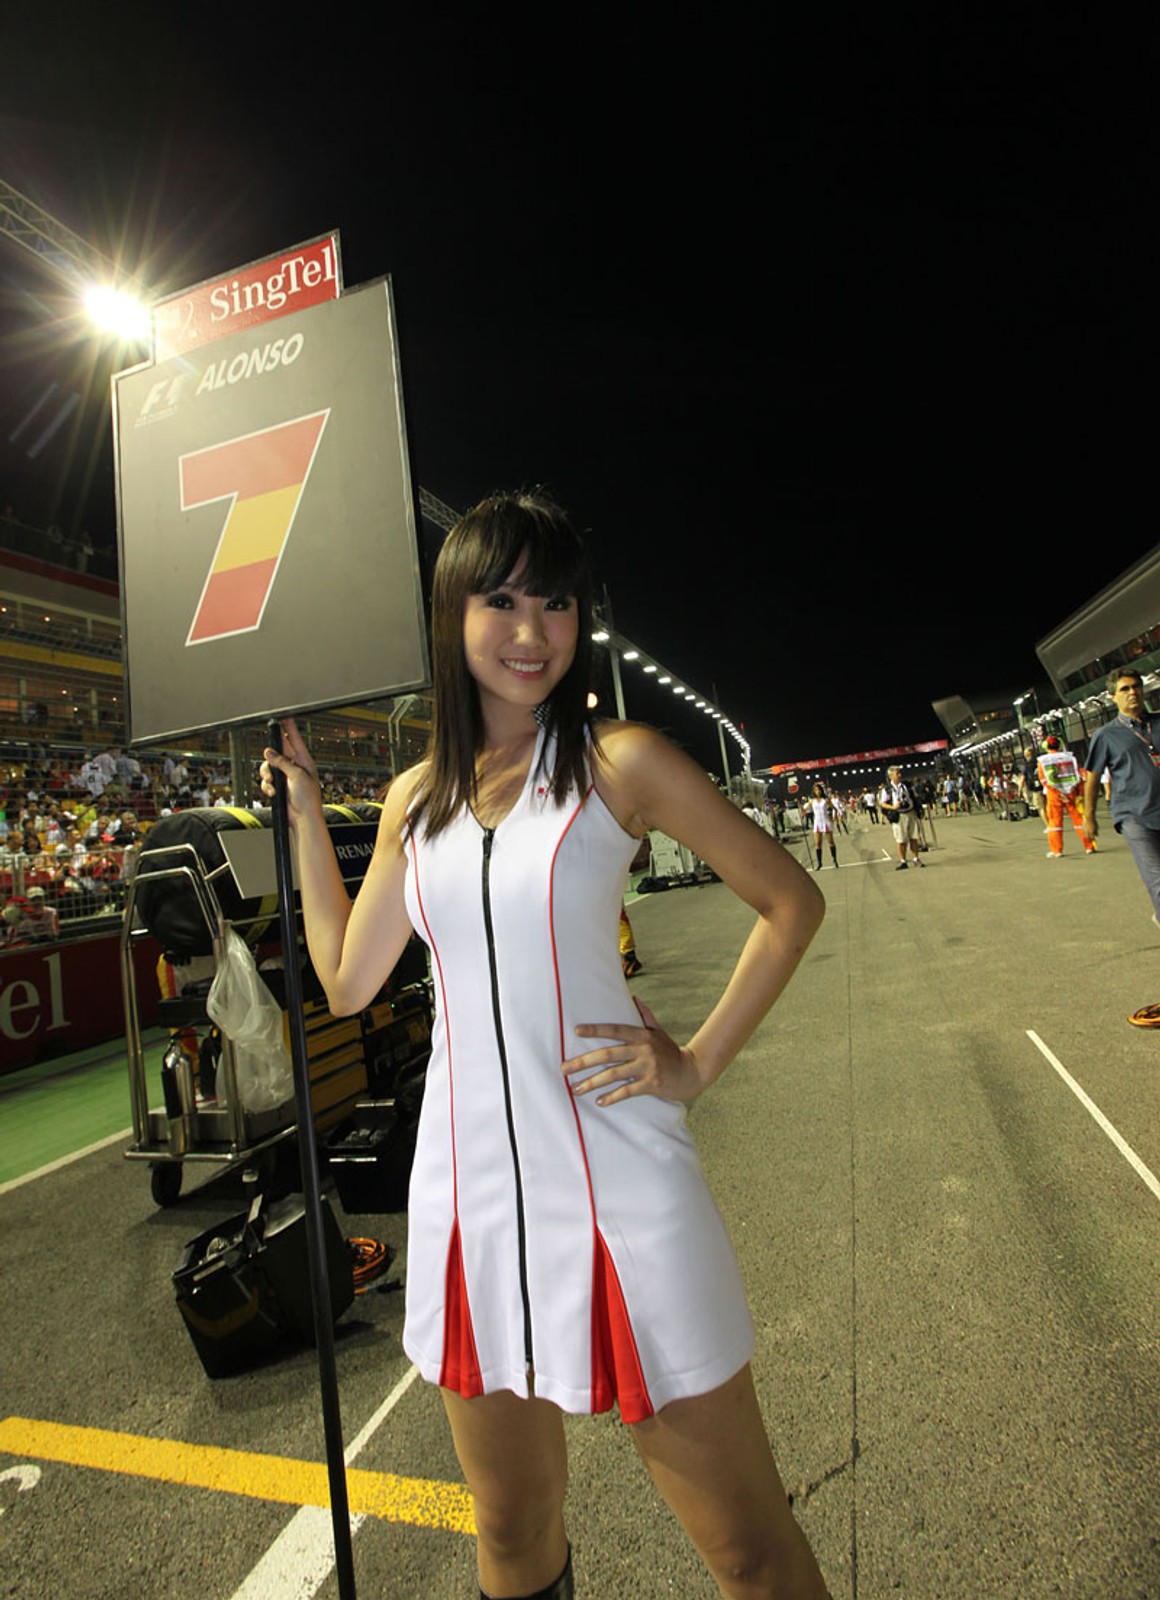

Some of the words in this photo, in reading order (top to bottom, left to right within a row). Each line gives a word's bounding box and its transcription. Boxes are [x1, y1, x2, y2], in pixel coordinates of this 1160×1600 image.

[210, 245, 336, 324] SingTel
[195, 332, 304, 396] ALONSO
[178, 406, 332, 647] 7
